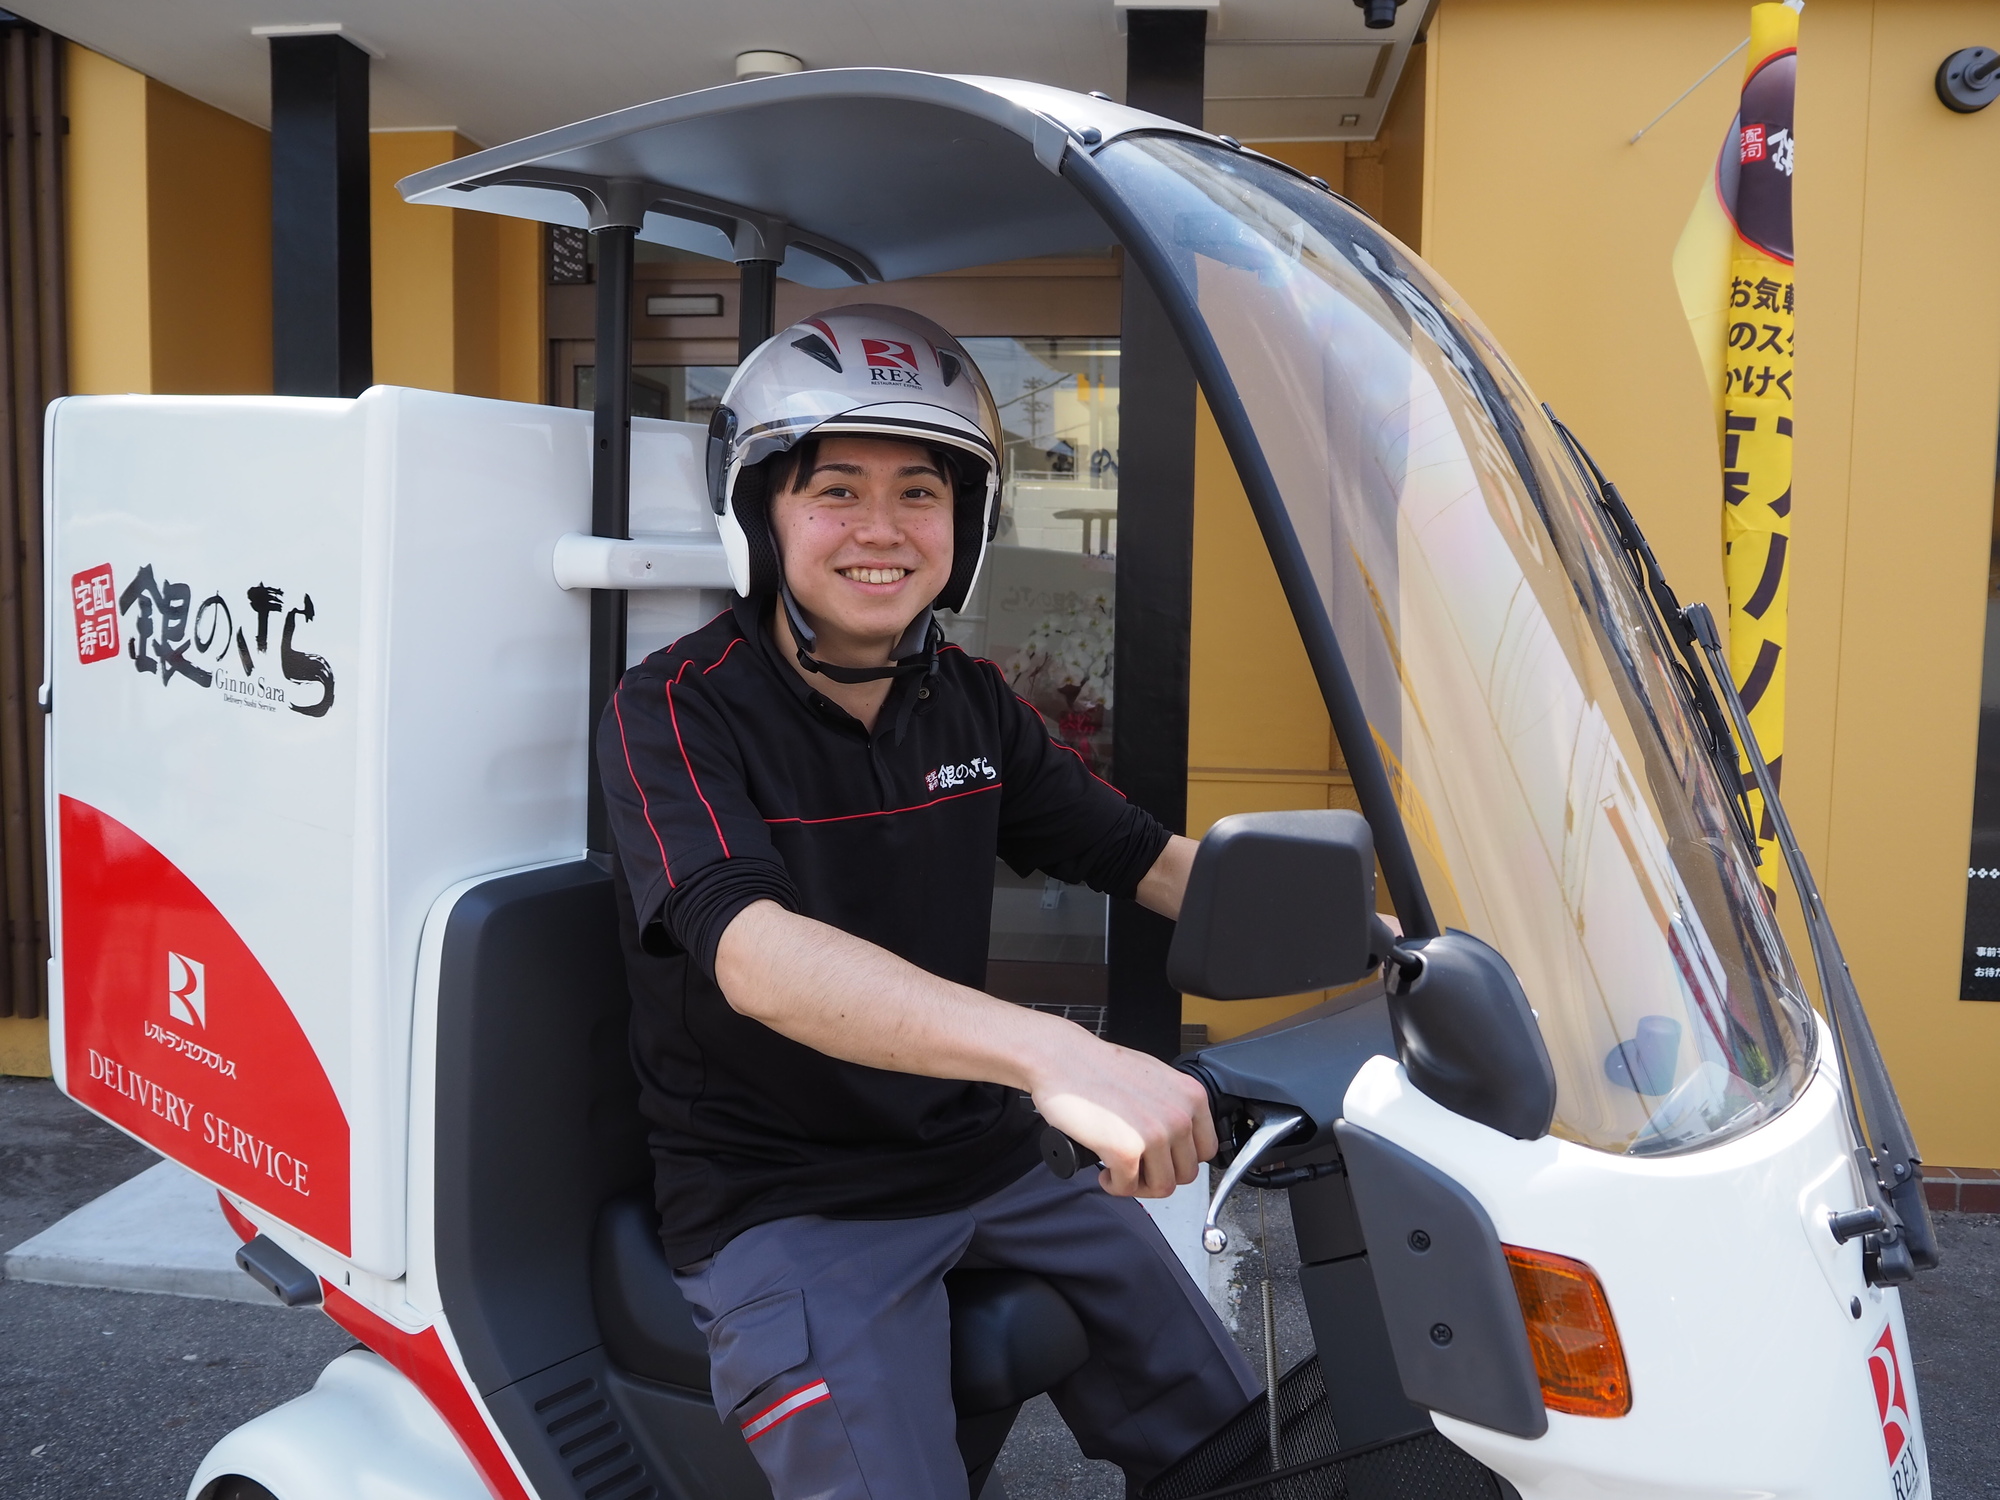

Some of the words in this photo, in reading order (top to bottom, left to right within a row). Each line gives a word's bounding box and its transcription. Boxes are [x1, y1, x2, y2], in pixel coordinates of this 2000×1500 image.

[869, 368, 921, 386] REX
[75, 574, 114, 615] 宅配
[79, 614, 115, 655] 寿司
[119, 563, 335, 718] 銀のさら
[257, 677, 285, 702] Sara
[938, 757, 996, 788] 銀のさら
[88, 1048, 195, 1132] DELIVERY
[203, 1112, 310, 1197] SERVICE
[1892, 1436, 1918, 1500] REX
